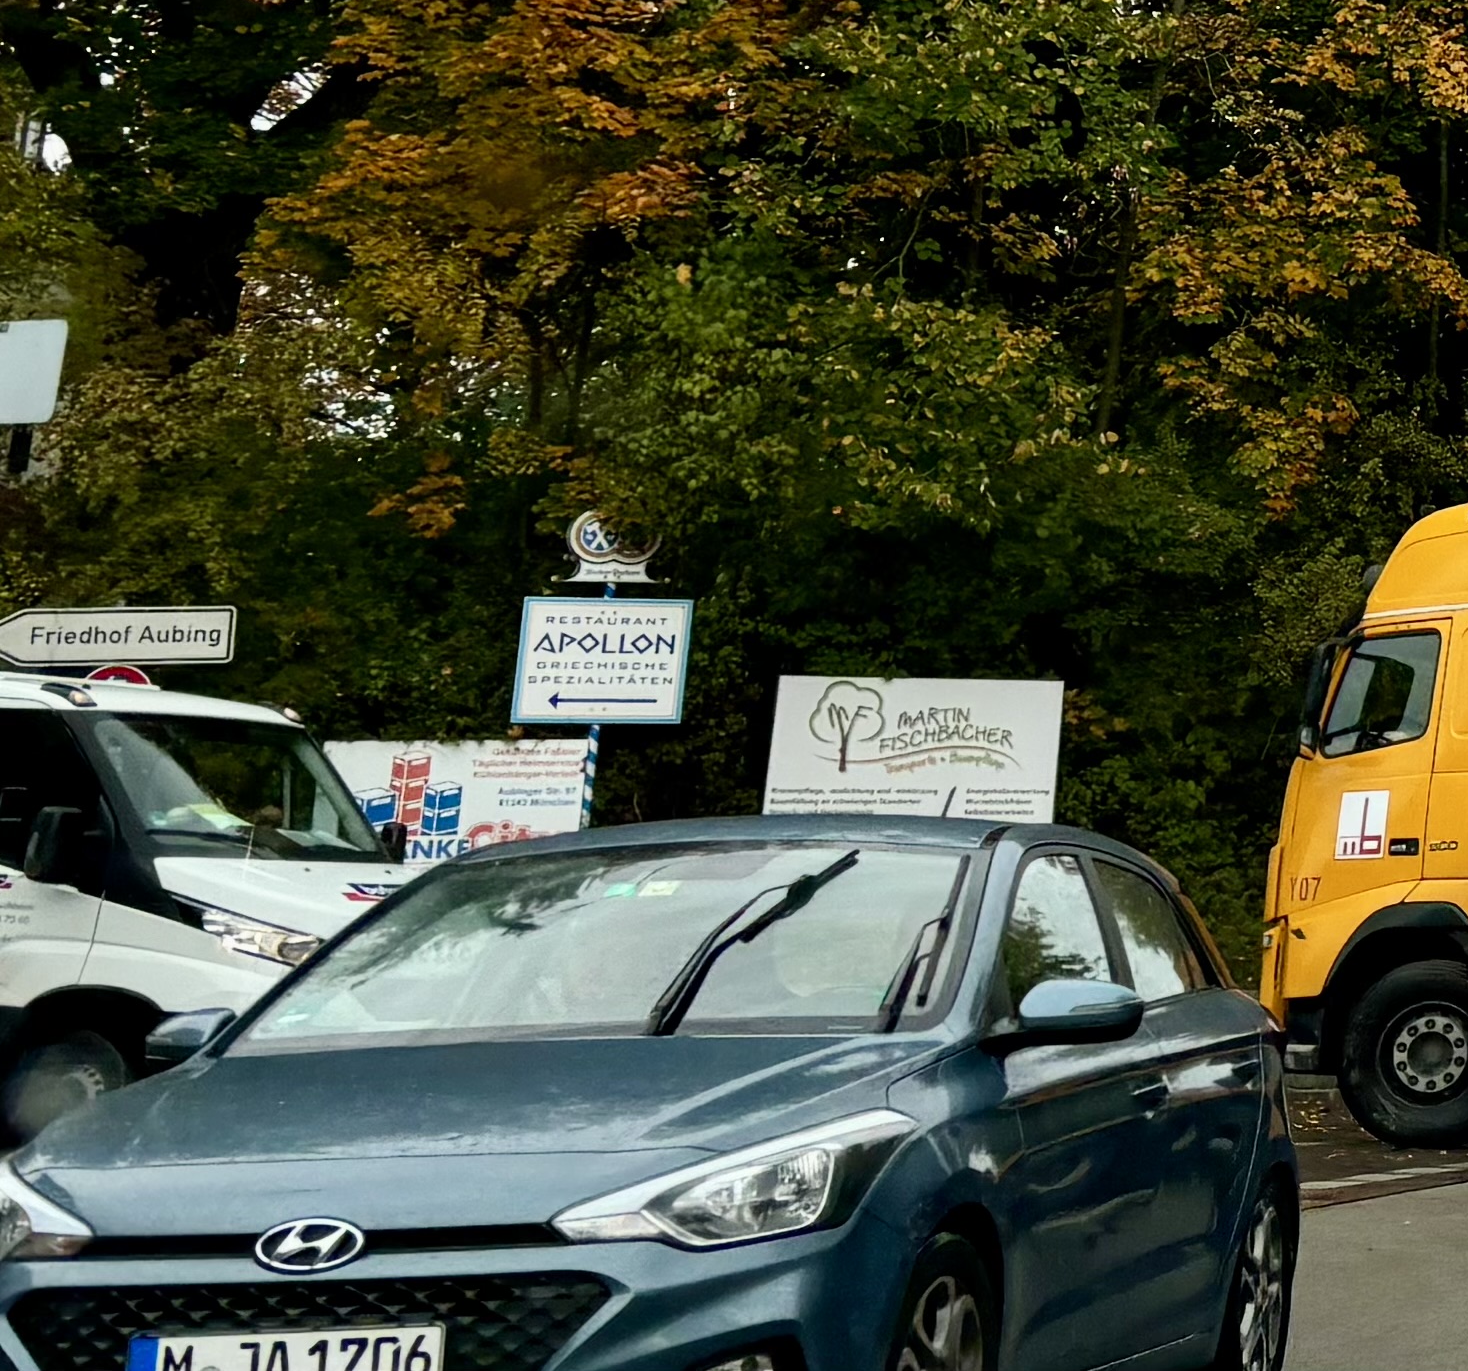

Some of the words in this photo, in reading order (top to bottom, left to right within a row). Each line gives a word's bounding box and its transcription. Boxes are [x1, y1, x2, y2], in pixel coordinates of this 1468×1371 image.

[545, 615, 669, 626] RESTAURANT
[30, 625, 132, 645] Friedhof
[138, 625, 222, 647] Aubing
[533, 632, 676, 655] APOLLON
[536, 661, 669, 671] GRIECHISCHE
[527, 673, 674, 685] SPEZIALITÄTEN
[897, 706, 971, 730] MARTIN
[878, 723, 1015, 754] FISCHBACHER
[163, 1345, 194, 1371] M
